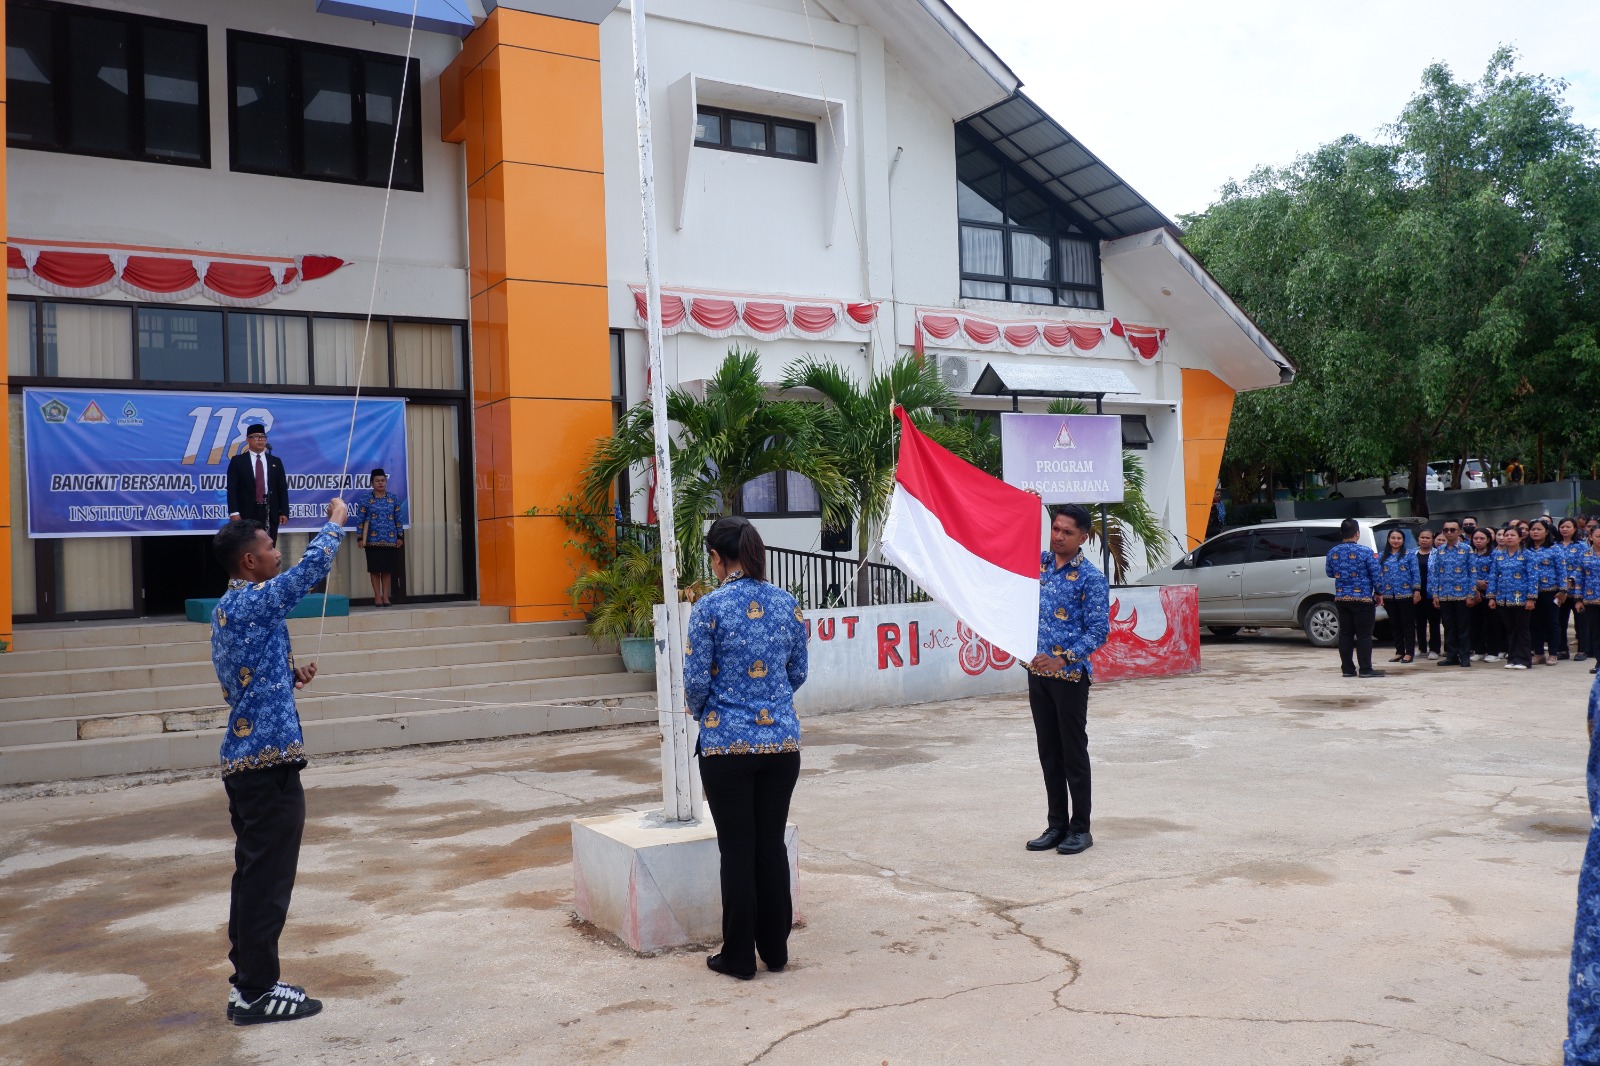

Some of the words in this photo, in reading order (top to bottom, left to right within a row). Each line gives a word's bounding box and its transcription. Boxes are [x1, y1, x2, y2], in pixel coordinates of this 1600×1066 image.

[181, 406, 274, 465] 118
[1036, 460, 1094, 473] PROGRAM
[51, 474, 118, 491] BANGKIT
[120, 474, 197, 493] BERSAMA,
[286, 474, 353, 490] NDONESIA
[1020, 480, 1109, 493] PASCASARJANA
[69, 505, 143, 521] INSTITUT
[144, 505, 201, 520] AGAMA
[877, 621, 920, 670] RI
